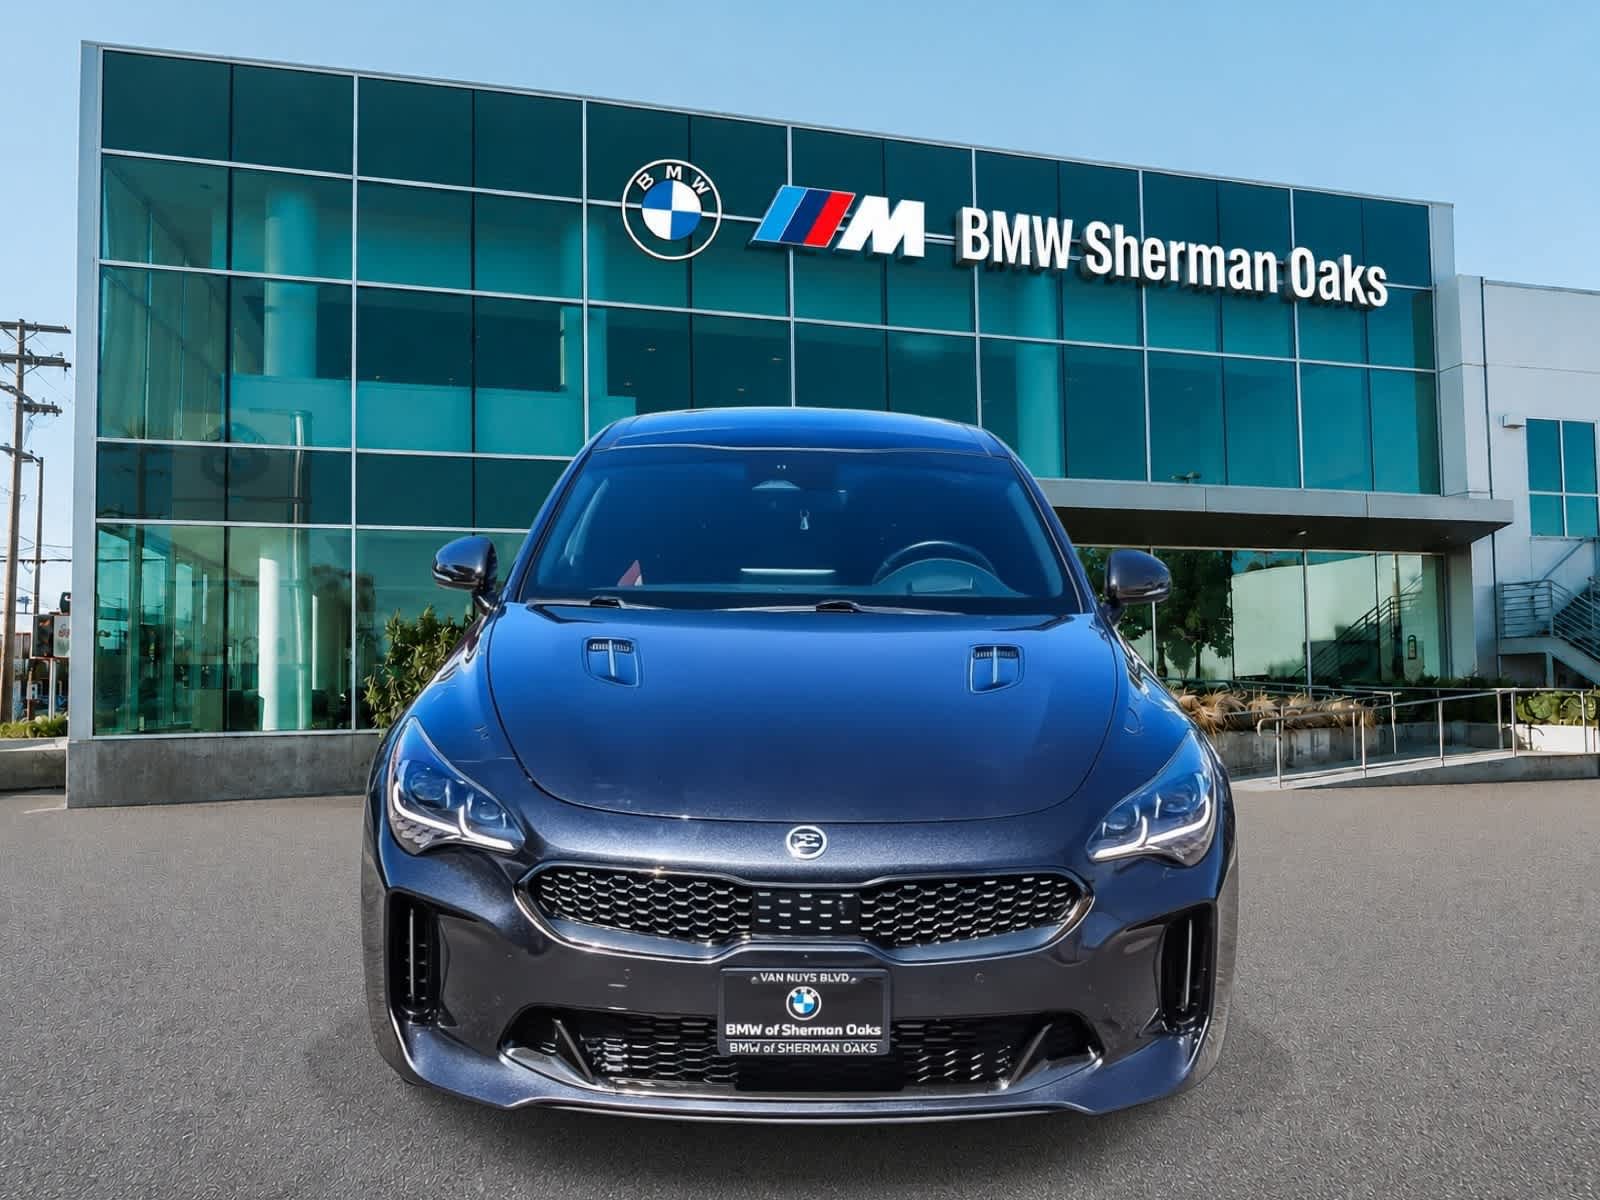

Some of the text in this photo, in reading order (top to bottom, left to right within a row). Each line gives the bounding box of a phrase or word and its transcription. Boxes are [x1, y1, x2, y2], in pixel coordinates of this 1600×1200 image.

[636, 165, 711, 195] BMW
[960, 206, 1388, 307] BMW Sherman Oaks
[760, 973, 849, 983] VAN NUYS BLVD
[726, 1024, 882, 1035] BMW of Sherman Oaks
[729, 1042, 877, 1053] BMW of SHERMAN OAKS
